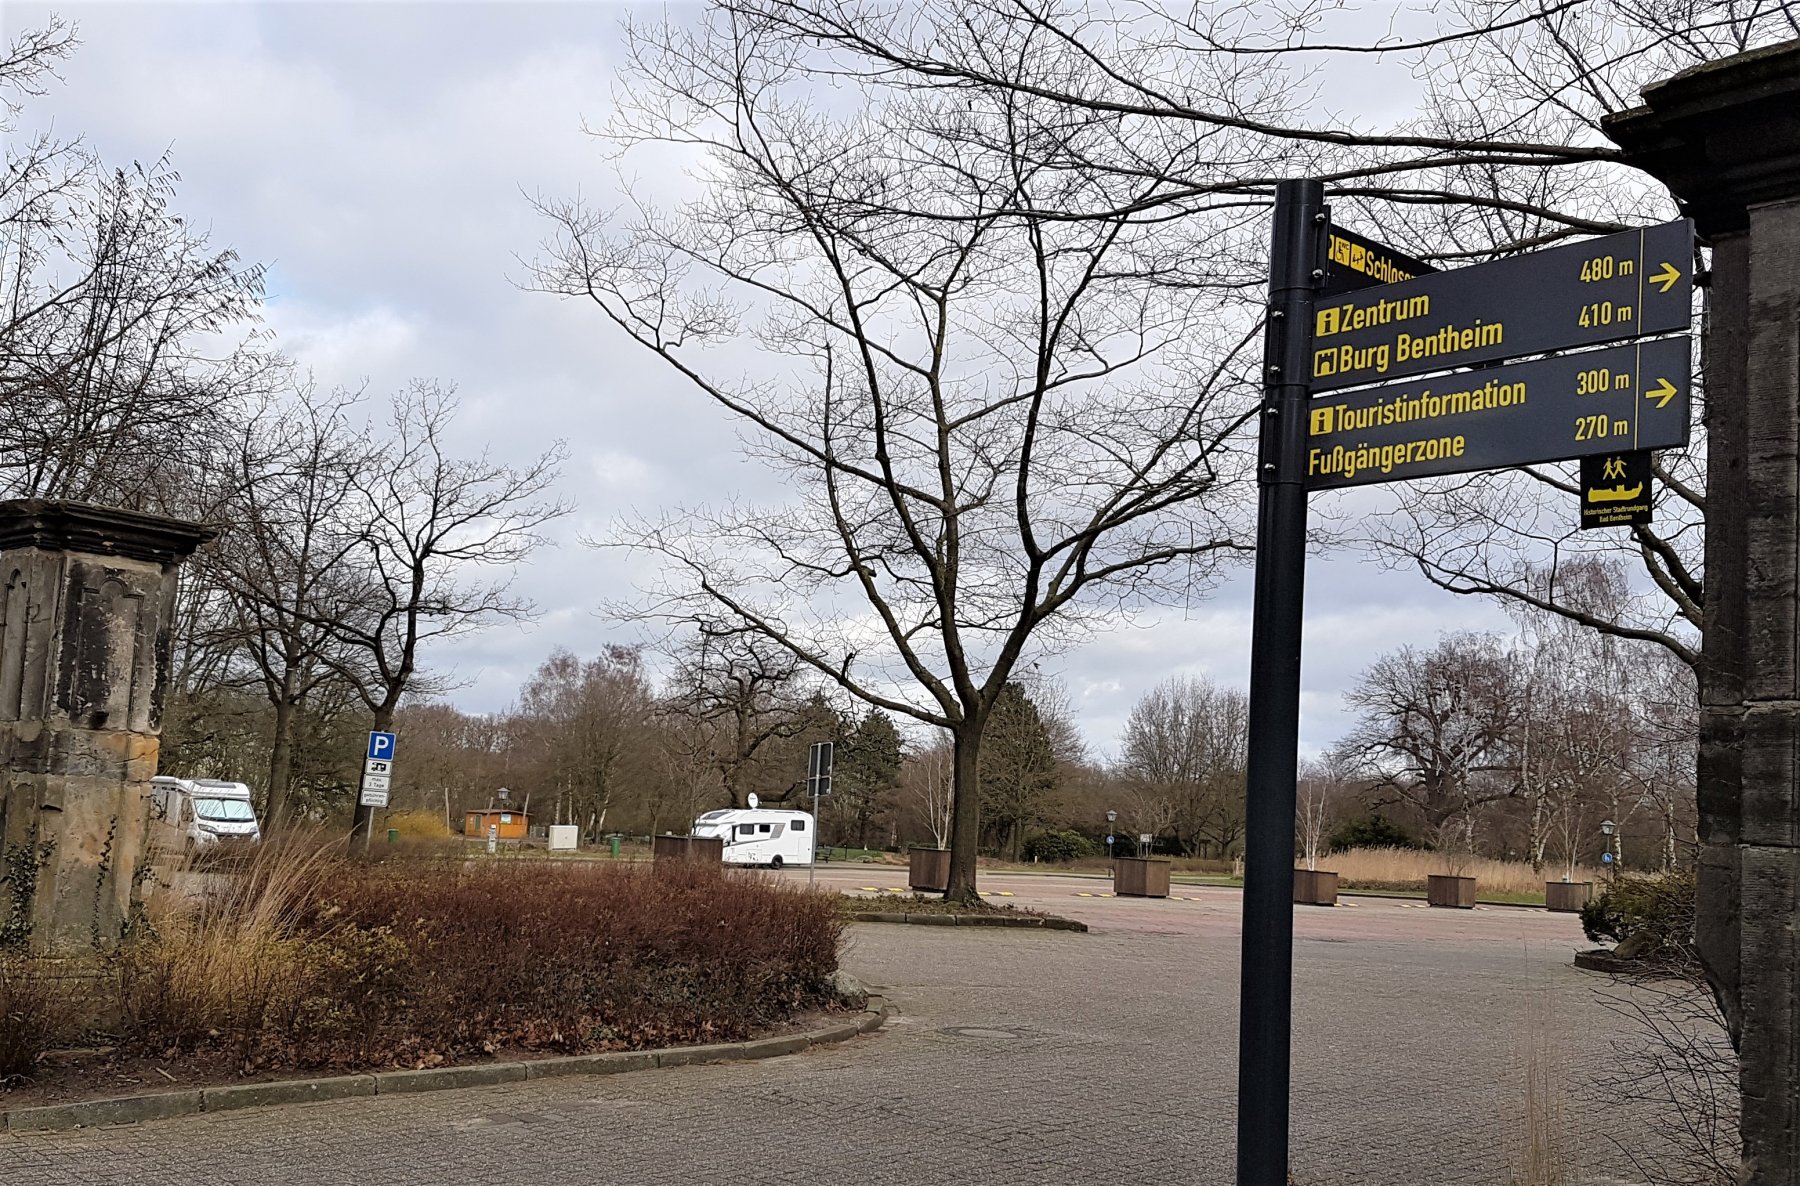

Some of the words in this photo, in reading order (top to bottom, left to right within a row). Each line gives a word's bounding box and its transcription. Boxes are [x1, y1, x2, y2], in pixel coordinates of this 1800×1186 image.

[1341, 295, 1430, 333] Zentrum
[1580, 256, 1614, 284] 480
[1619, 260, 1634, 276] m
[1365, 249, 1417, 284] Schlos
[1340, 344, 1390, 373] Burg
[1396, 320, 1504, 362] Bentheim
[1578, 302, 1612, 329] 410
[1618, 306, 1633, 322] m
[1337, 380, 1526, 432] Touristinformation
[1576, 369, 1610, 396] 300
[1615, 373, 1630, 389] m
[1309, 435, 1466, 479] Fußgängerzone
[1575, 415, 1608, 442] 270
[1614, 419, 1629, 436] m
[374, 736, 389, 755] P
